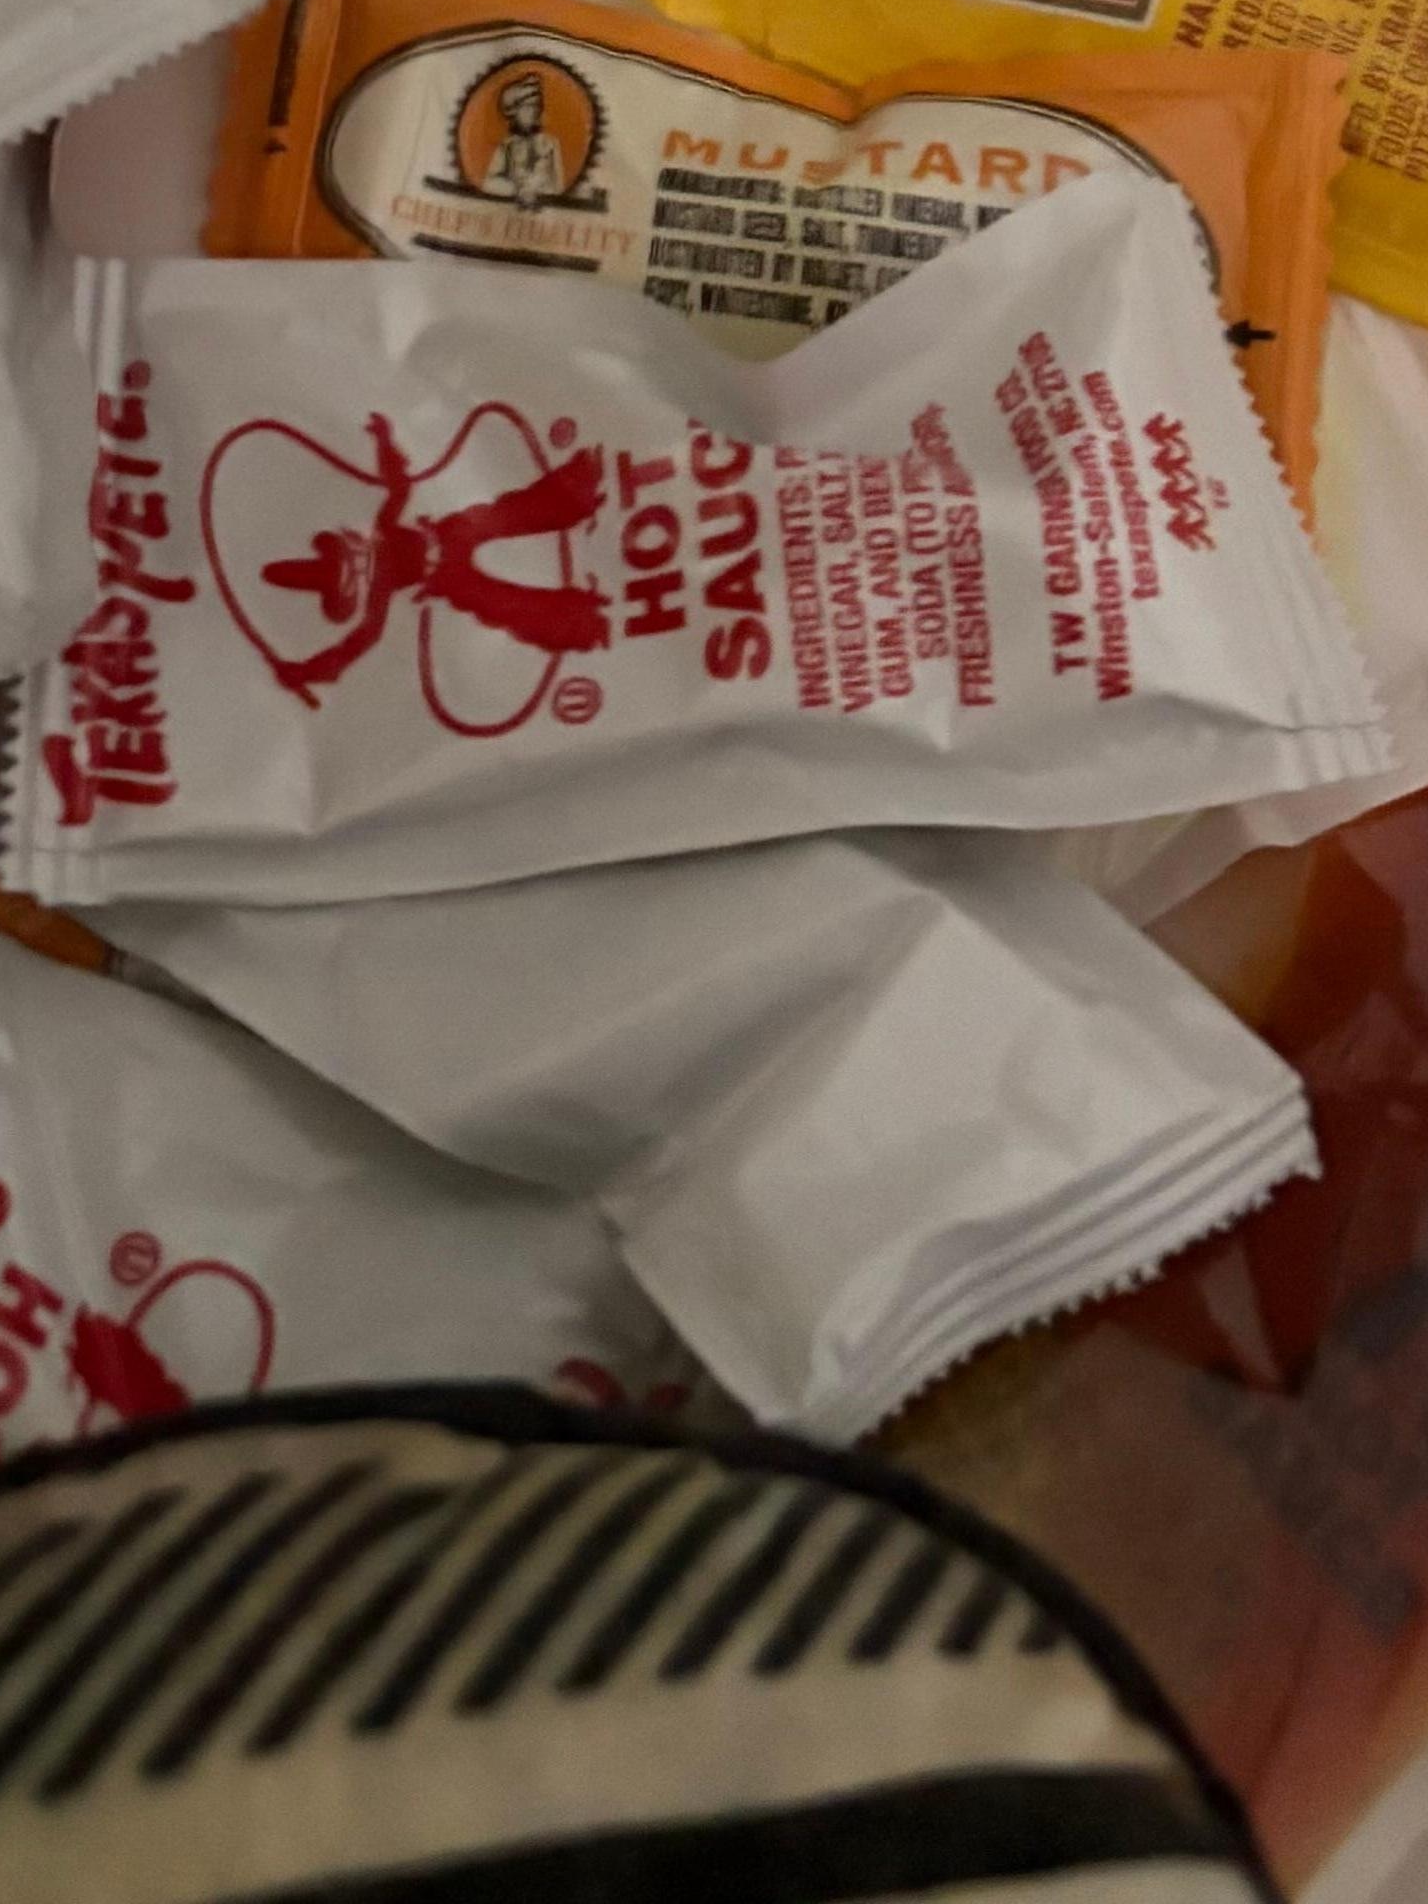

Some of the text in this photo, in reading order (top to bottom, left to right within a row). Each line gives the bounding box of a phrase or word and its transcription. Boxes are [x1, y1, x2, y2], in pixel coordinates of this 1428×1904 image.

[1374, 89, 1418, 167] FOODS
[618, 448, 686, 638] HOT
[687, 418, 773, 682] SAUC
[872, 530, 898, 594] AND
[908, 503, 945, 552] (TO
[1077, 436, 1130, 698] Winston-Salem,
[1082, 372, 1159, 598] texaspete.com
[785, 476, 829, 707] INGREDIENTS:
[818, 463, 872, 710] VINEGAR, SALT,
[876, 607, 912, 694] GUM,
[914, 565, 947, 657] SODA
[952, 505, 993, 704] FRESHNESS
[43, 596, 177, 828] TEXAS
